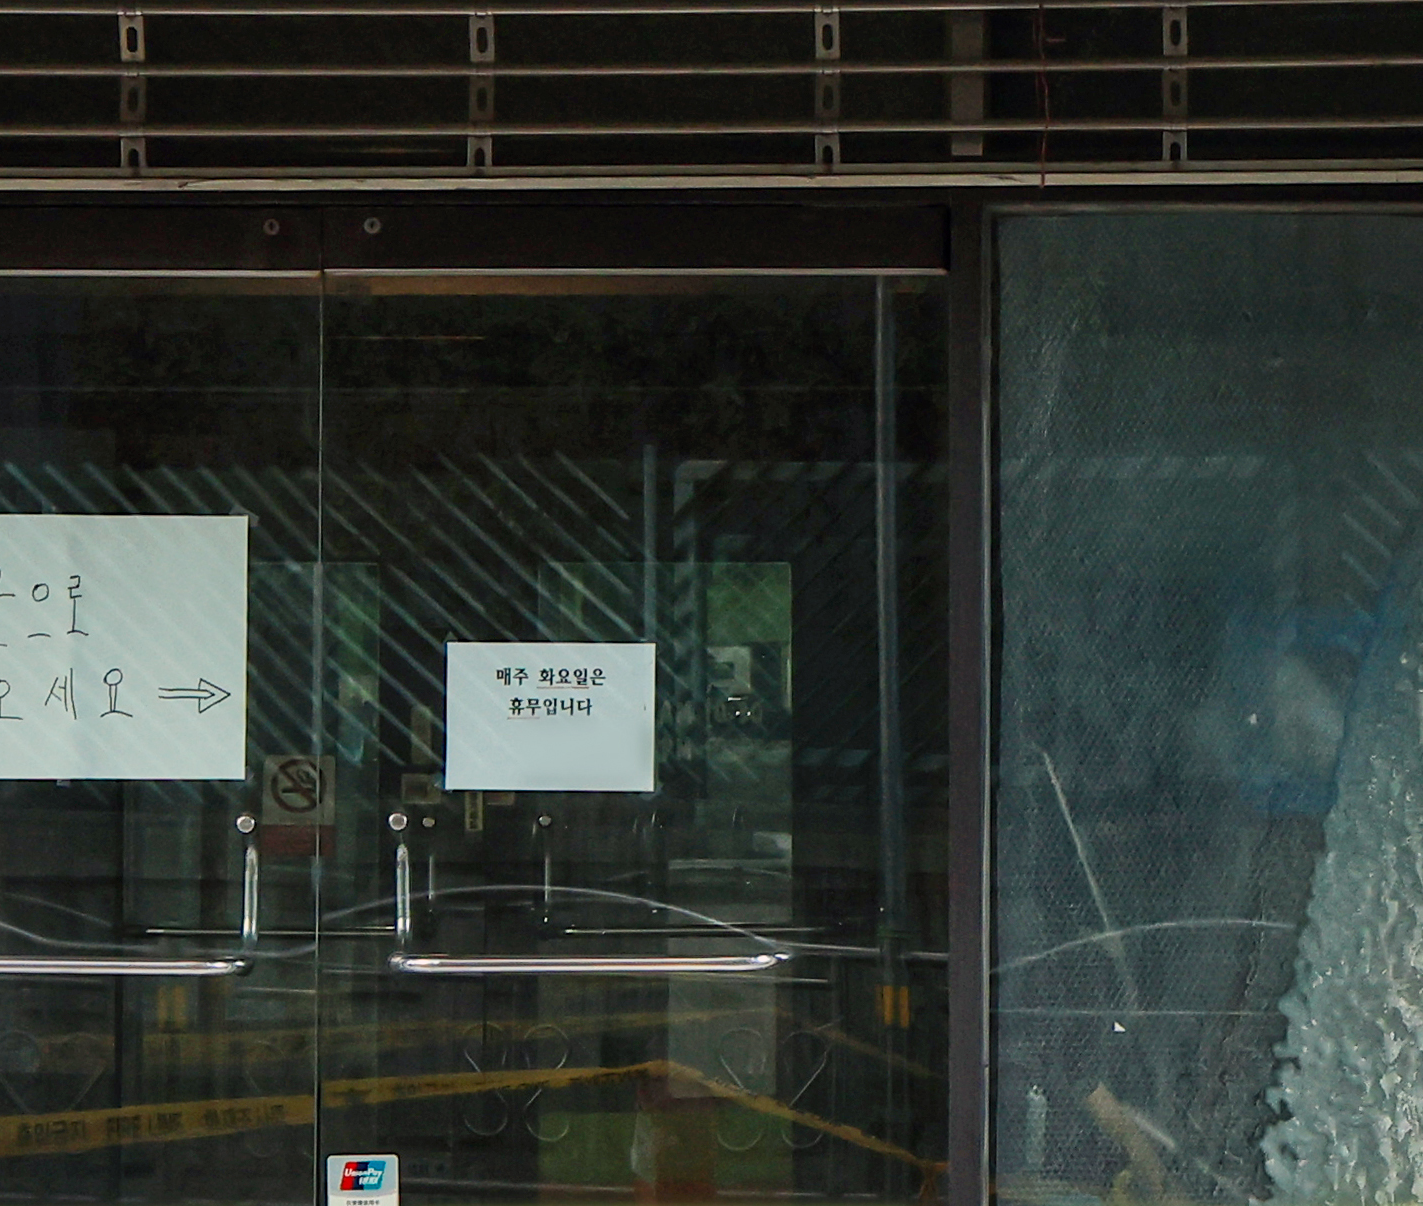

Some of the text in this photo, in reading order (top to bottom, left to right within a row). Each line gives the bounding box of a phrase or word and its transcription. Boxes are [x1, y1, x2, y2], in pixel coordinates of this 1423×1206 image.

[495, 666, 607, 687] 매주 화요일은
[508, 696, 593, 717] 휴무입니다
